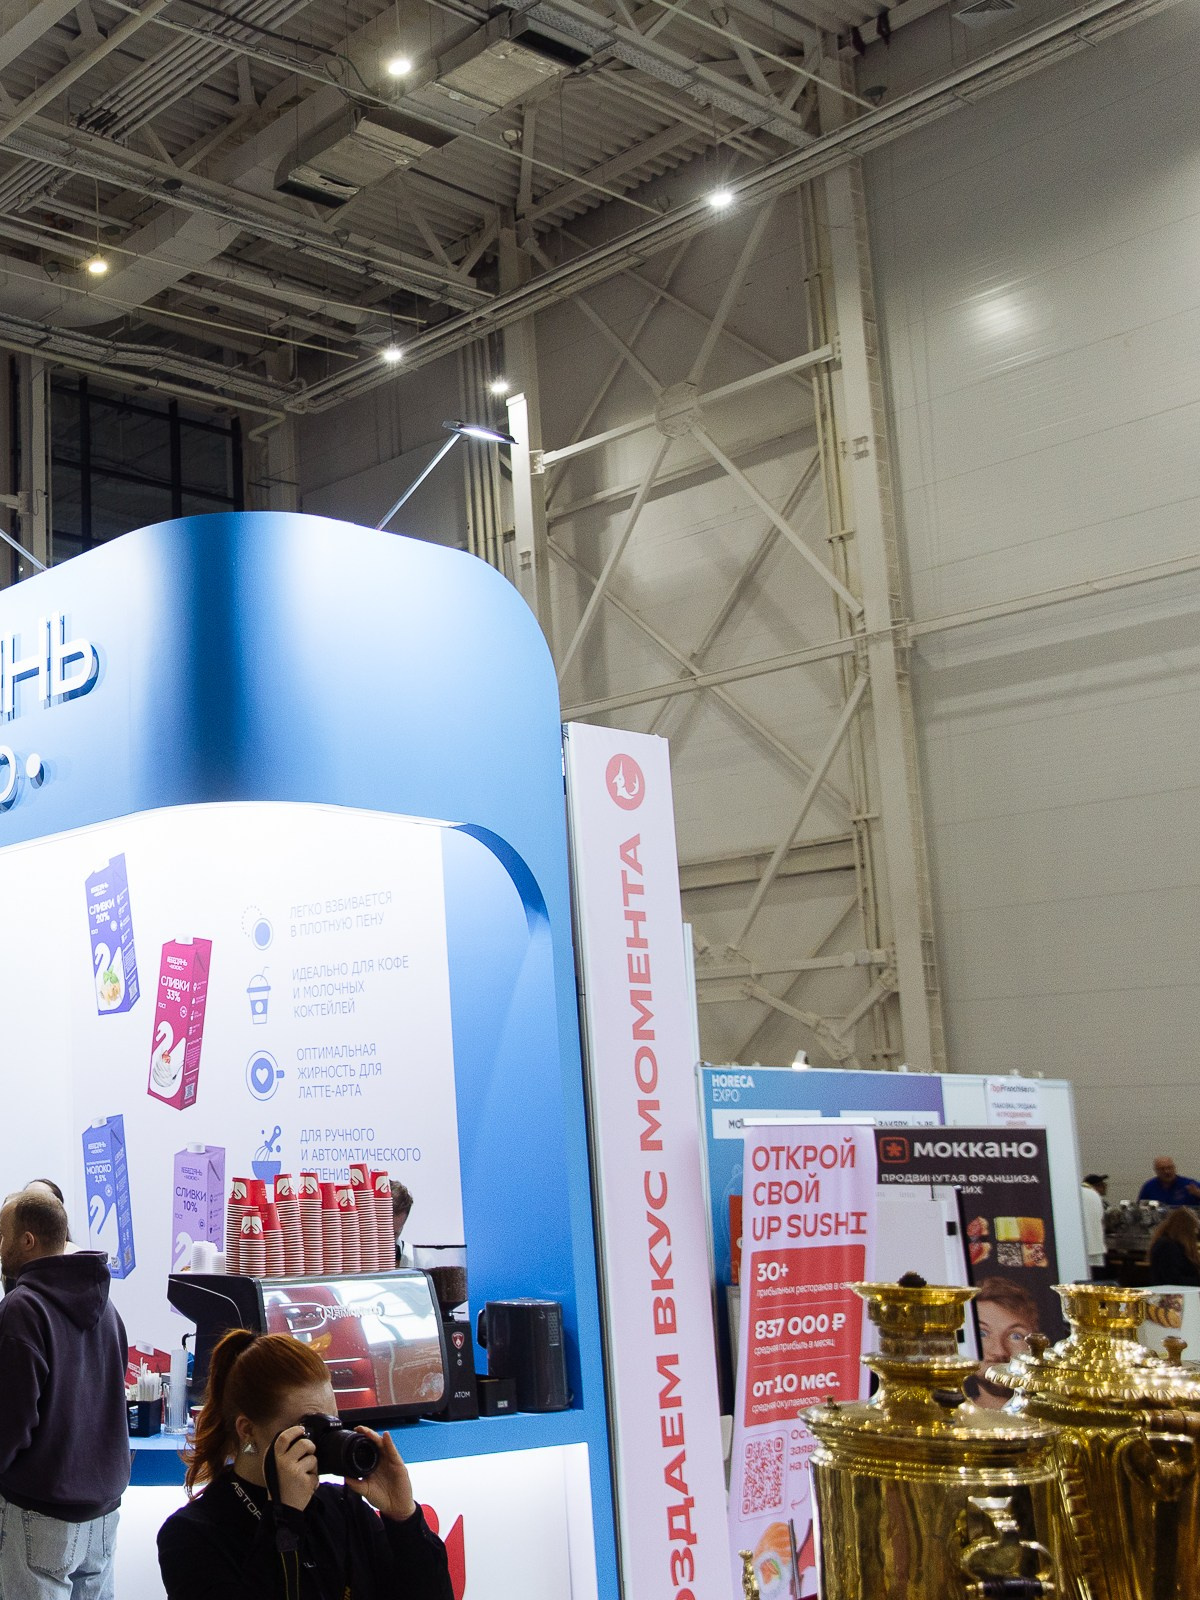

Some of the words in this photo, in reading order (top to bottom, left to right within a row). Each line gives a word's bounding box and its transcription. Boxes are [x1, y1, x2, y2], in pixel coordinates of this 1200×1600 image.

[89, 898, 115, 916] СЛИВКИ
[289, 902, 322, 919] ЛЕГКО
[325, 891, 393, 914] ВЗБИВАЕТСЯ
[290, 925, 297, 938] В
[300, 917, 353, 936] ПЛОТНУЮ
[356, 912, 385, 928] ПЕНУ
[292, 962, 349, 982] ИДЕАЛЬНО
[351, 959, 374, 976] ДЛЯ
[378, 955, 410, 972] КОФЕ
[161, 975, 190, 992] СЛИВКИ
[293, 986, 300, 1000] И
[303, 980, 365, 999] МОЛОЧНЫХ
[619, 833, 663, 1152] МОМЕНТА
[166, 989, 181, 1003] 33%
[293, 997, 356, 1018] КОКТЕЙЛЕЙ
[296, 1043, 377, 1061] ОПТИМАЛЬНАЯ
[297, 1064, 356, 1080] ЖИРНОСТЬ
[359, 1063, 382, 1078] ДЛЯ
[711, 1074, 755, 1088] HORECA
[298, 1084, 362, 1099] ЛАТТЕ-АРТА
[712, 1088, 741, 1102] EXPO
[300, 1129, 322, 1144] ДЛЯ
[325, 1128, 375, 1142] РУЧНОГО
[301, 1149, 308, 1161] И
[311, 1147, 421, 1162] АВТОМАТИЧЕСКОГО
[752, 1136, 856, 1172] ОТКРОЙ
[86, 1163, 112, 1175] МОЛОКО
[881, 1174, 966, 1184] ПРОДВИНУТАЯ
[968, 1173, 1040, 1184] ФРАНШИЗА
[175, 1186, 207, 1202] СЛИВКИ
[753, 1172, 820, 1207] СВОЙ
[183, 1200, 198, 1213] 10%
[752, 1216, 782, 1241] UP
[786, 1211, 867, 1239] SUSHI
[643, 1170, 677, 1335] ВКУС
[756, 1261, 789, 1282] 30+
[756, 1286, 795, 1298] прибыльных
[796, 1283, 833, 1295] ресторанов
[755, 1317, 785, 1339] 837
[787, 1313, 829, 1336] 000
[801, 1371, 841, 1391] мес.
[454, 1391, 471, 1399] ATOM
[789, 1443, 816, 1456] заяв
[656, 1353, 698, 1600] ЗДАЕМ
